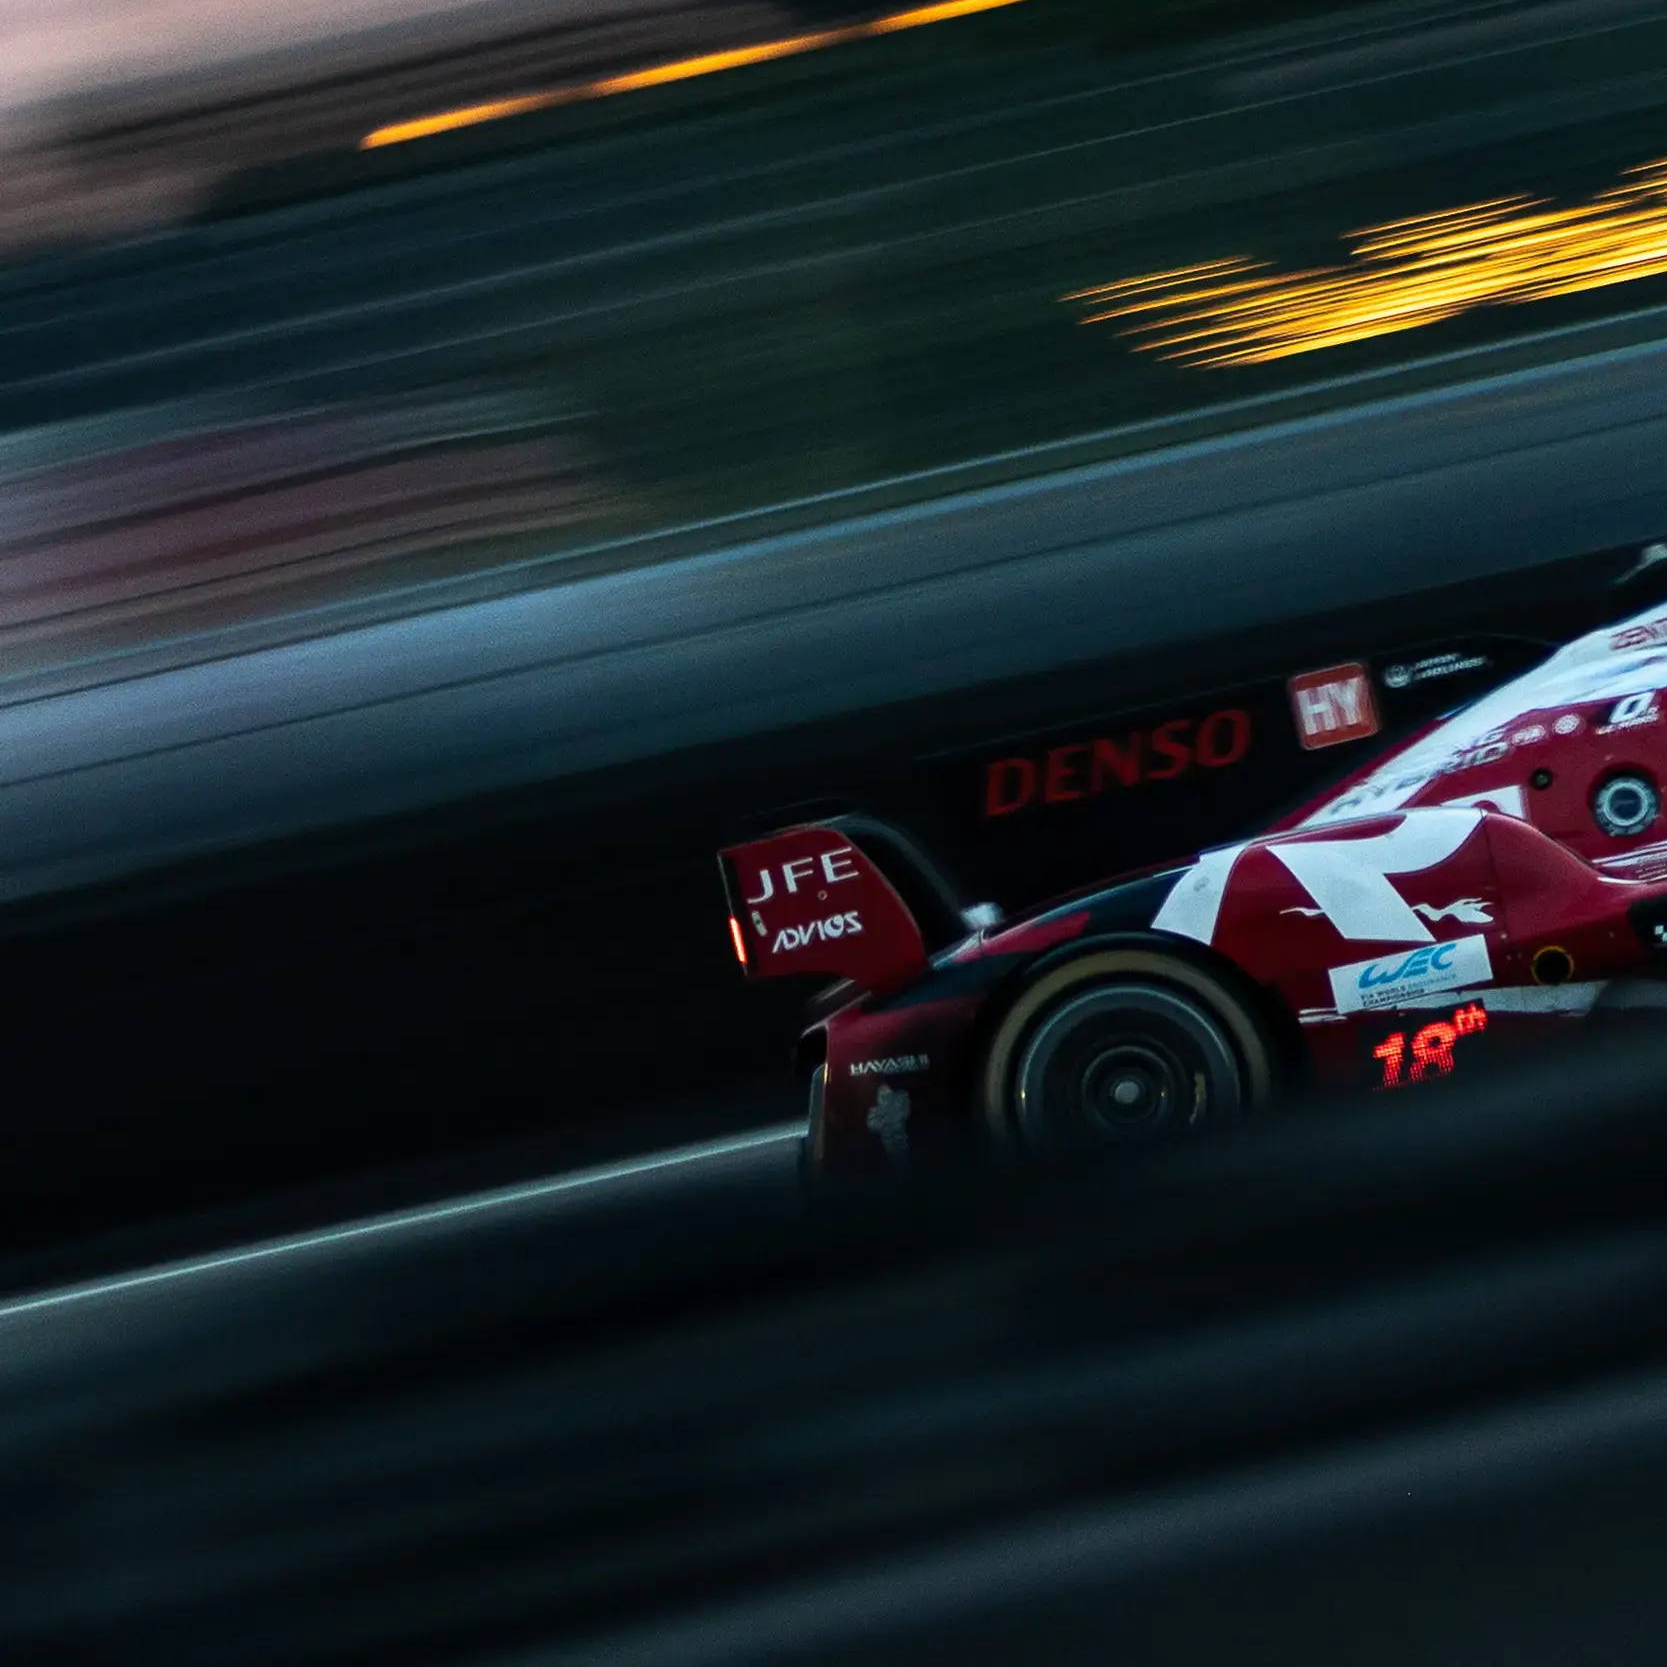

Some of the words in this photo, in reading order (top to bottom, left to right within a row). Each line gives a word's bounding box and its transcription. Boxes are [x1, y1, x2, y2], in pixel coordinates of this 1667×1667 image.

[1297, 675, 1365, 736] HY
[985, 708, 1252, 816] DENSO
[748, 847, 859, 904] JFE
[1358, 942, 1457, 989] WEC
